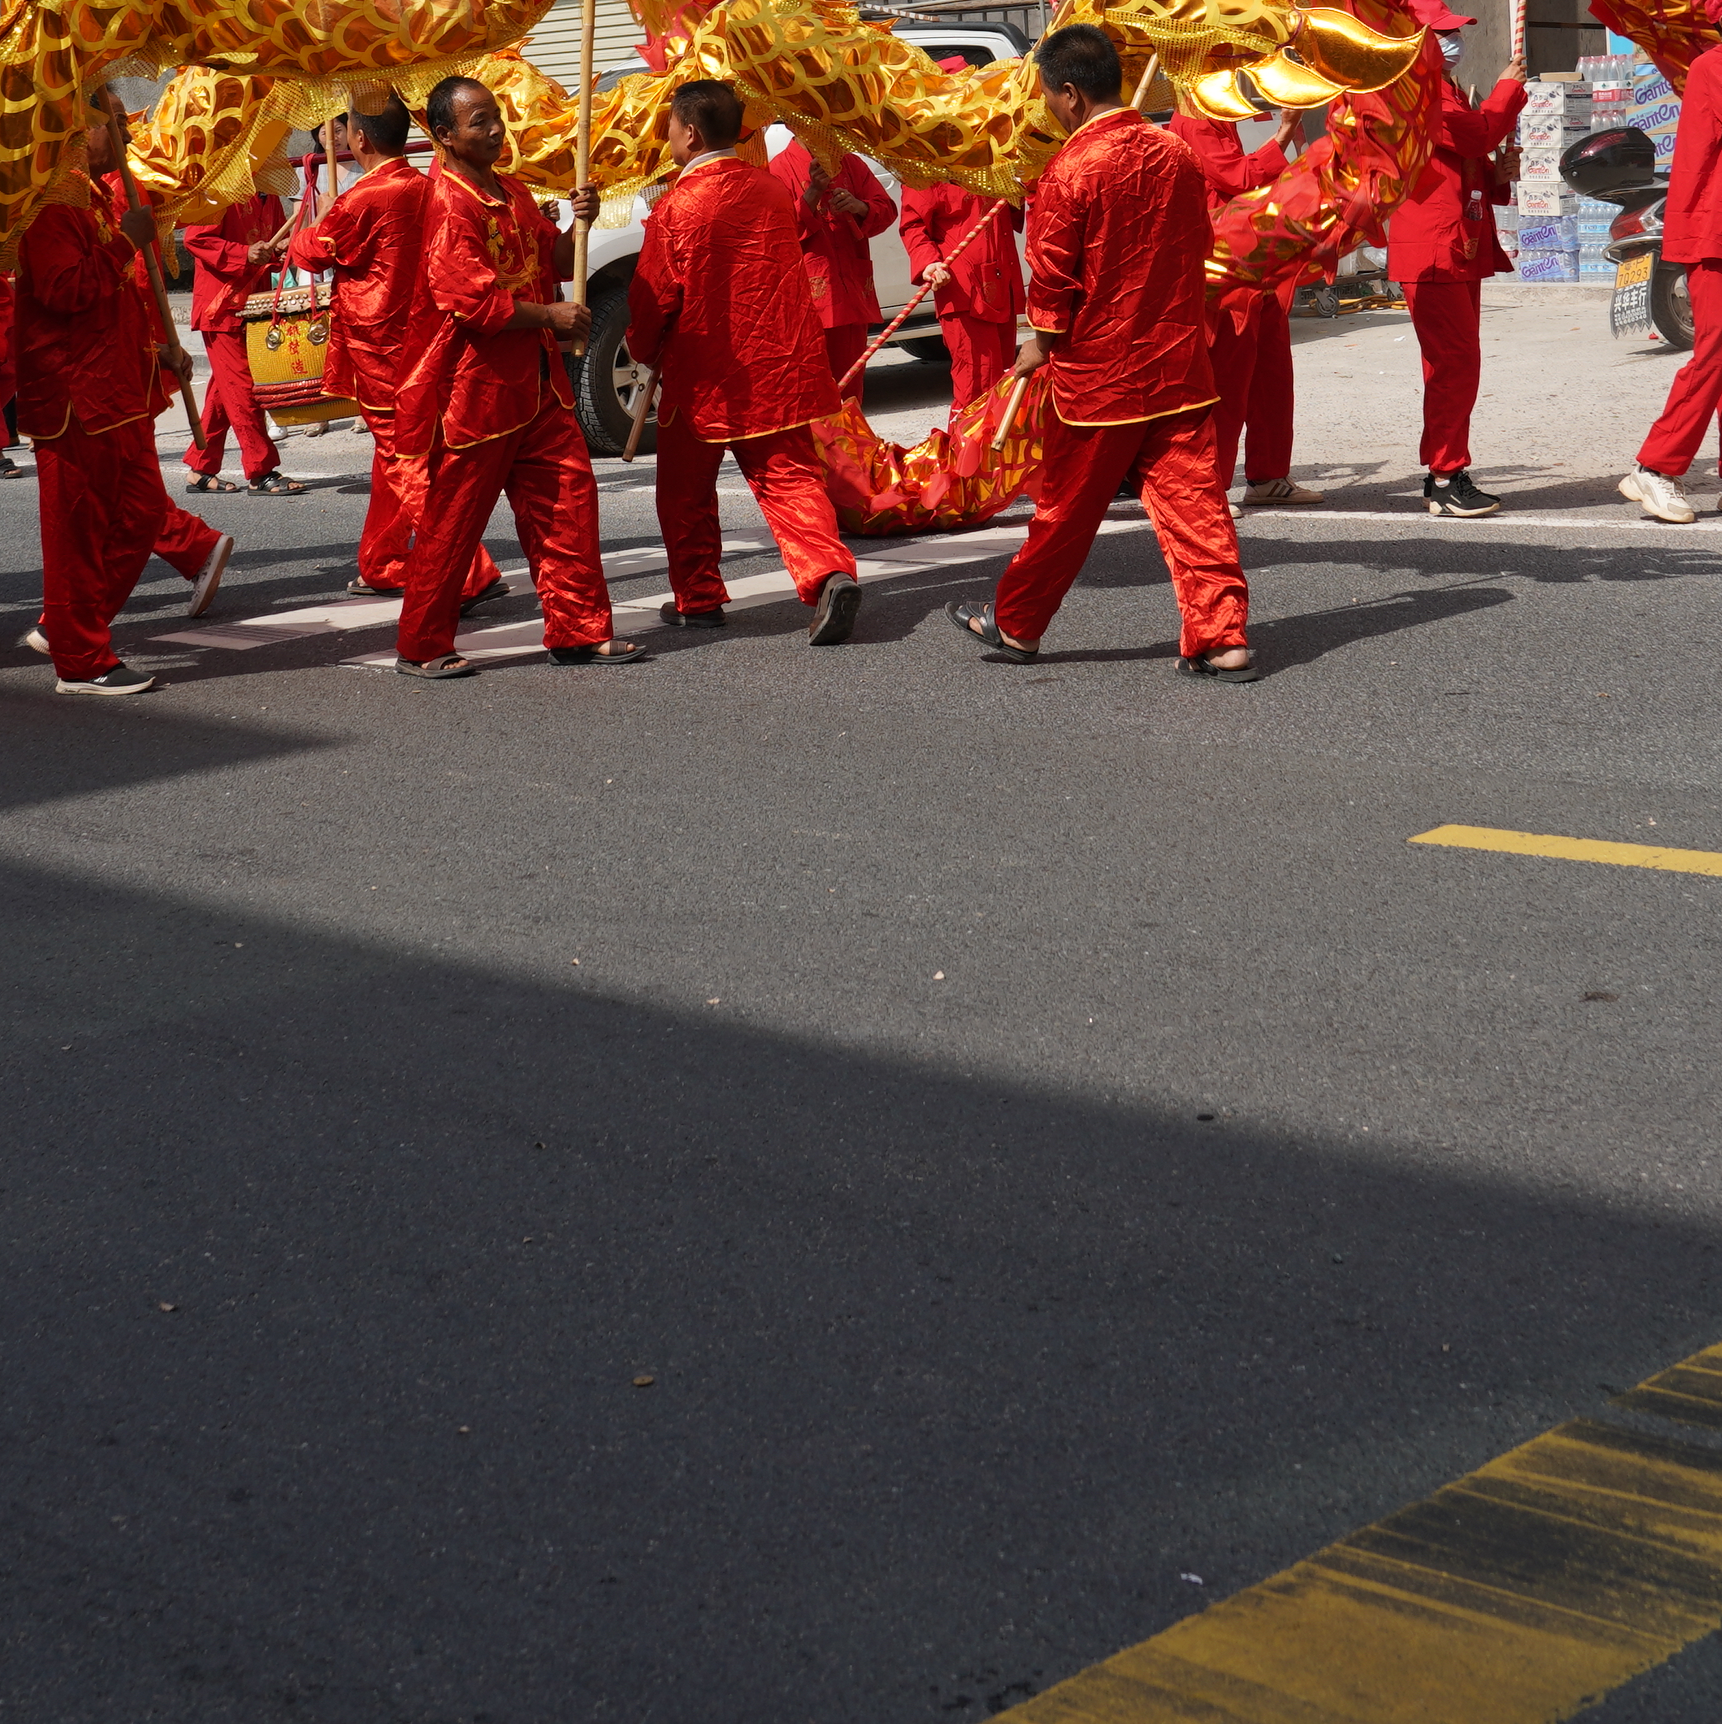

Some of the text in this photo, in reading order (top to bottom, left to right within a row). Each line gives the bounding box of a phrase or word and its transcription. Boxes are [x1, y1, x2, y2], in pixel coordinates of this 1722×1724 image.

[1521, 225, 1556, 246] Ganten
[1521, 256, 1558, 278] Ganten
[1614, 286, 1647, 312] 兴华车行
